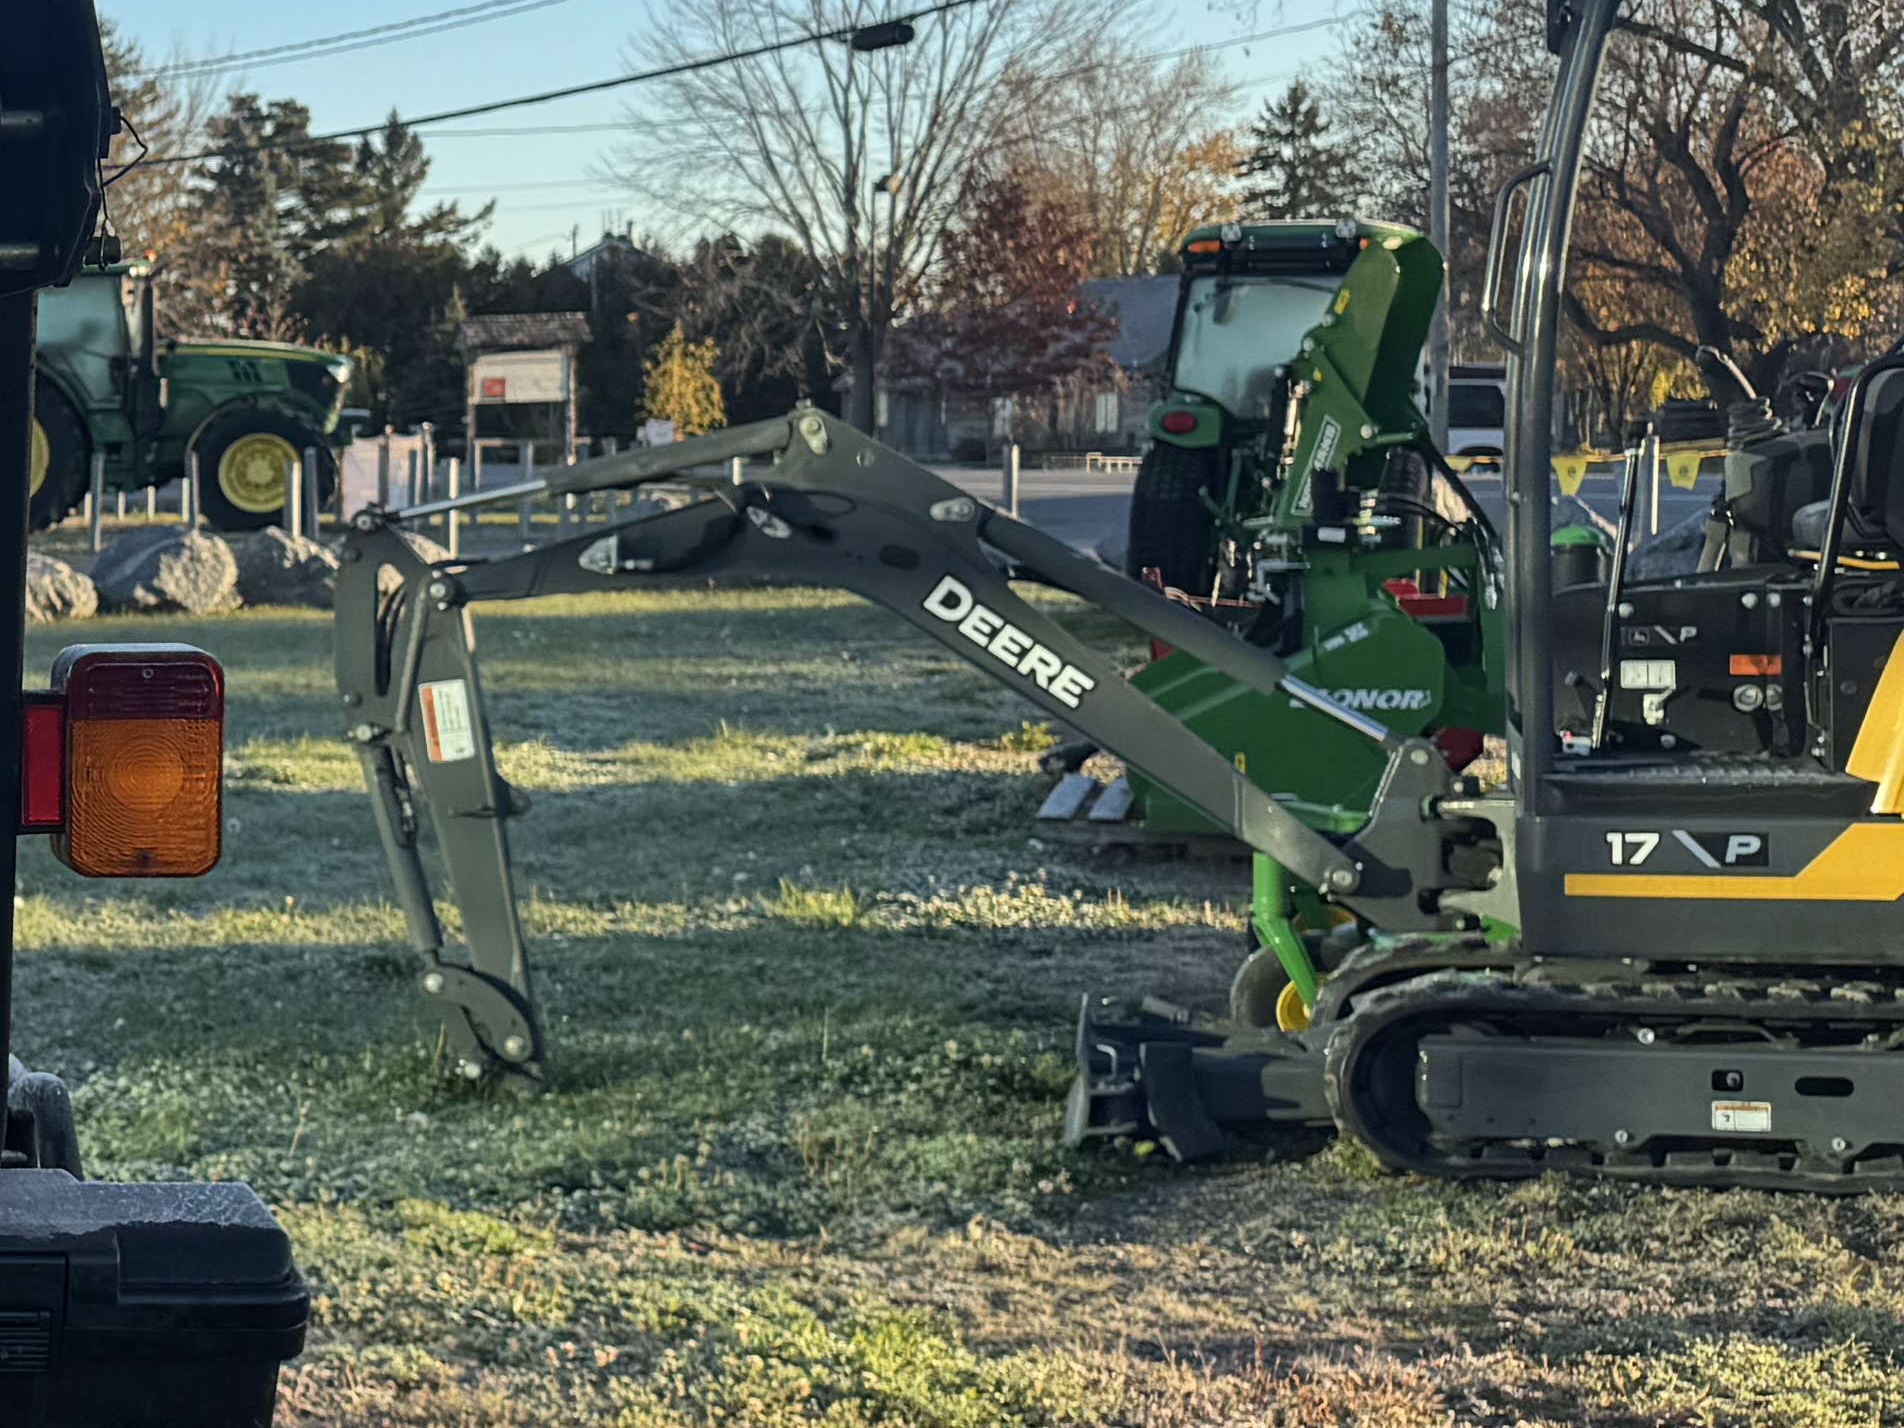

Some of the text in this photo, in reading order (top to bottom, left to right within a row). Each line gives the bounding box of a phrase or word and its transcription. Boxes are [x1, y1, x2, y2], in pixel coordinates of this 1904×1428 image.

[923, 575, 1095, 709] DEERE
[1606, 832, 1762, 865] 17 P
